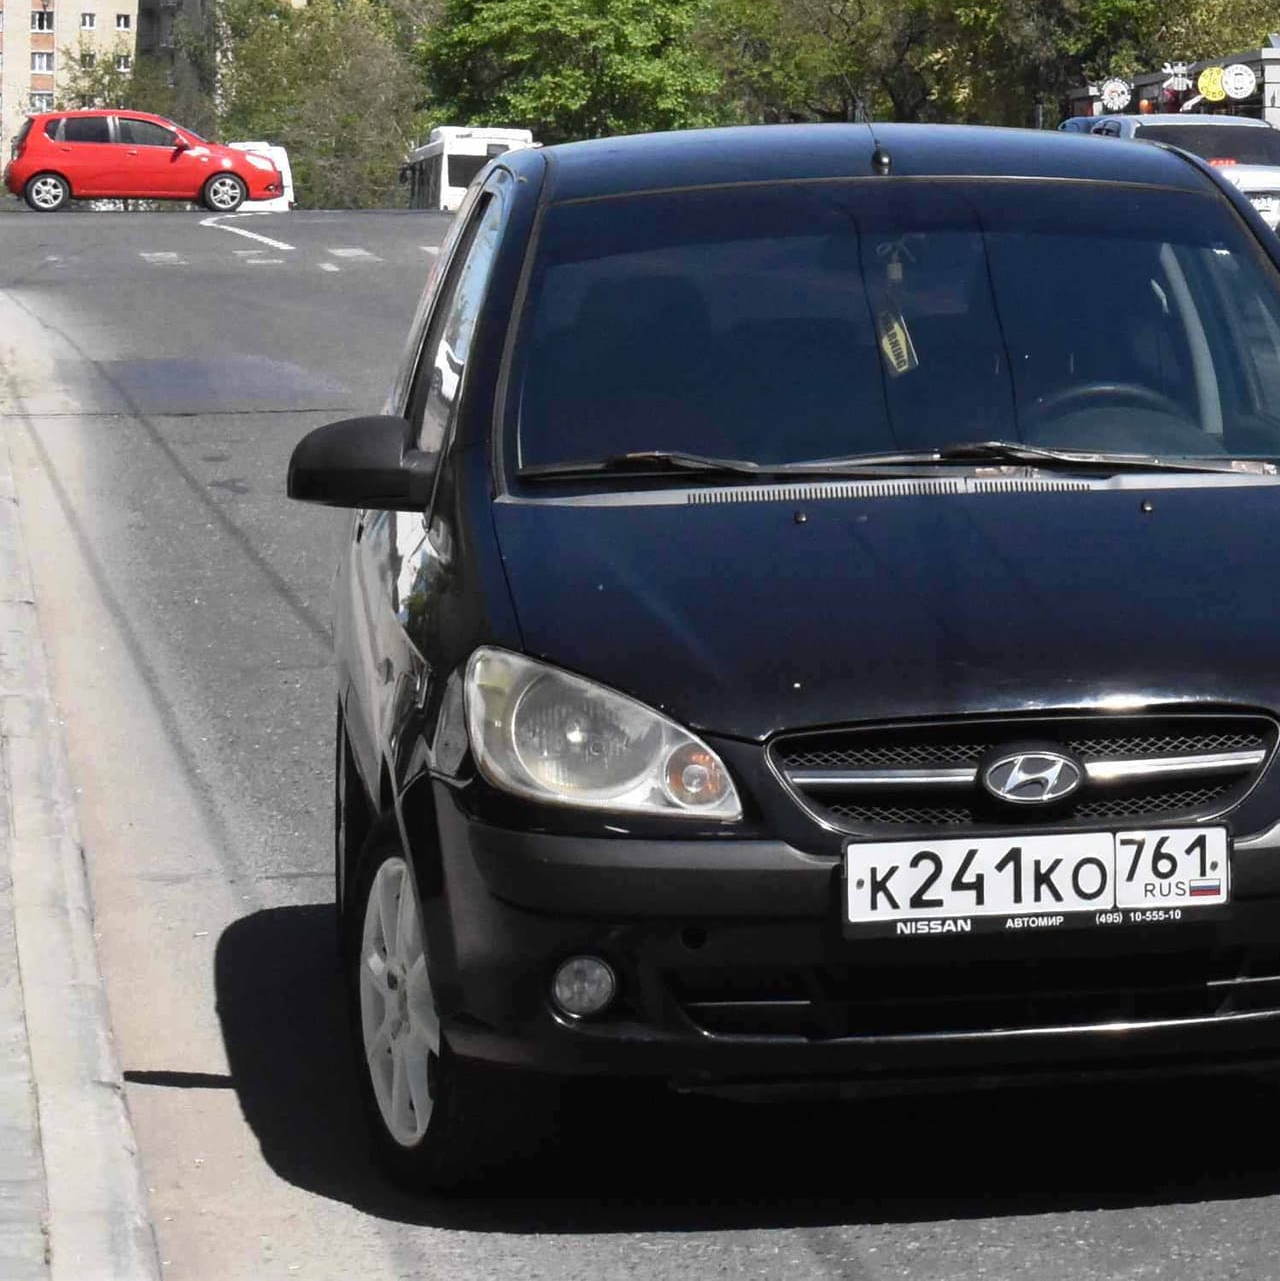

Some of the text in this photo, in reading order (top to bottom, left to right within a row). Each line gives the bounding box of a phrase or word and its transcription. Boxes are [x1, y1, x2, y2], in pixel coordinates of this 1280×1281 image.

[868, 833, 1208, 911] К241КО 761
[1143, 881, 1187, 899] RUS
[896, 908, 1182, 935] NISSAN АВТОМИР (495) 10-555-10
